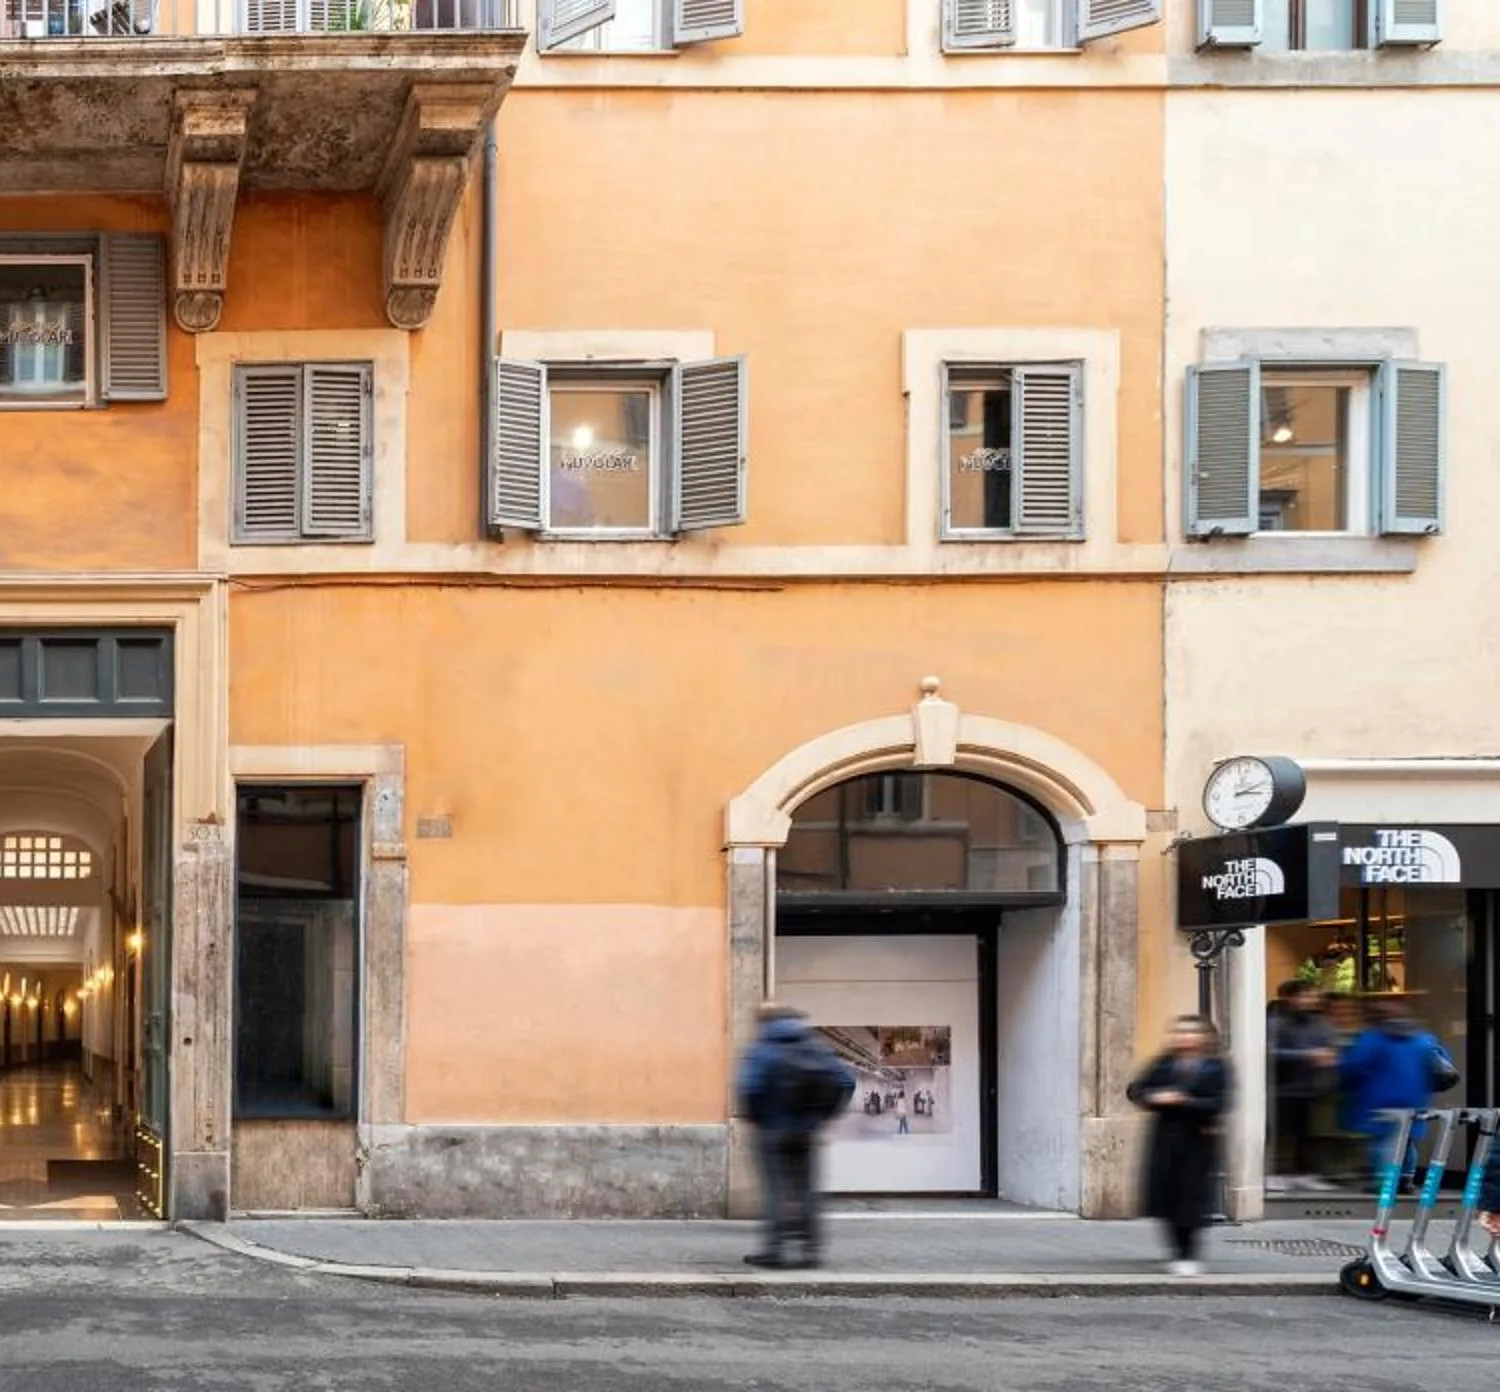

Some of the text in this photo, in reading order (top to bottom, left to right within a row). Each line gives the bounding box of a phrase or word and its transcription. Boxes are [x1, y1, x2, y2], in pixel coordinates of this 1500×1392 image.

[1376, 829, 1421, 847] THE
[1343, 847, 1421, 865] NORTH
[1224, 858, 1256, 875] THE
[1363, 865, 1421, 883] FACE
[1202, 871, 1256, 890] NORTH
[1217, 884, 1256, 900] FACE
